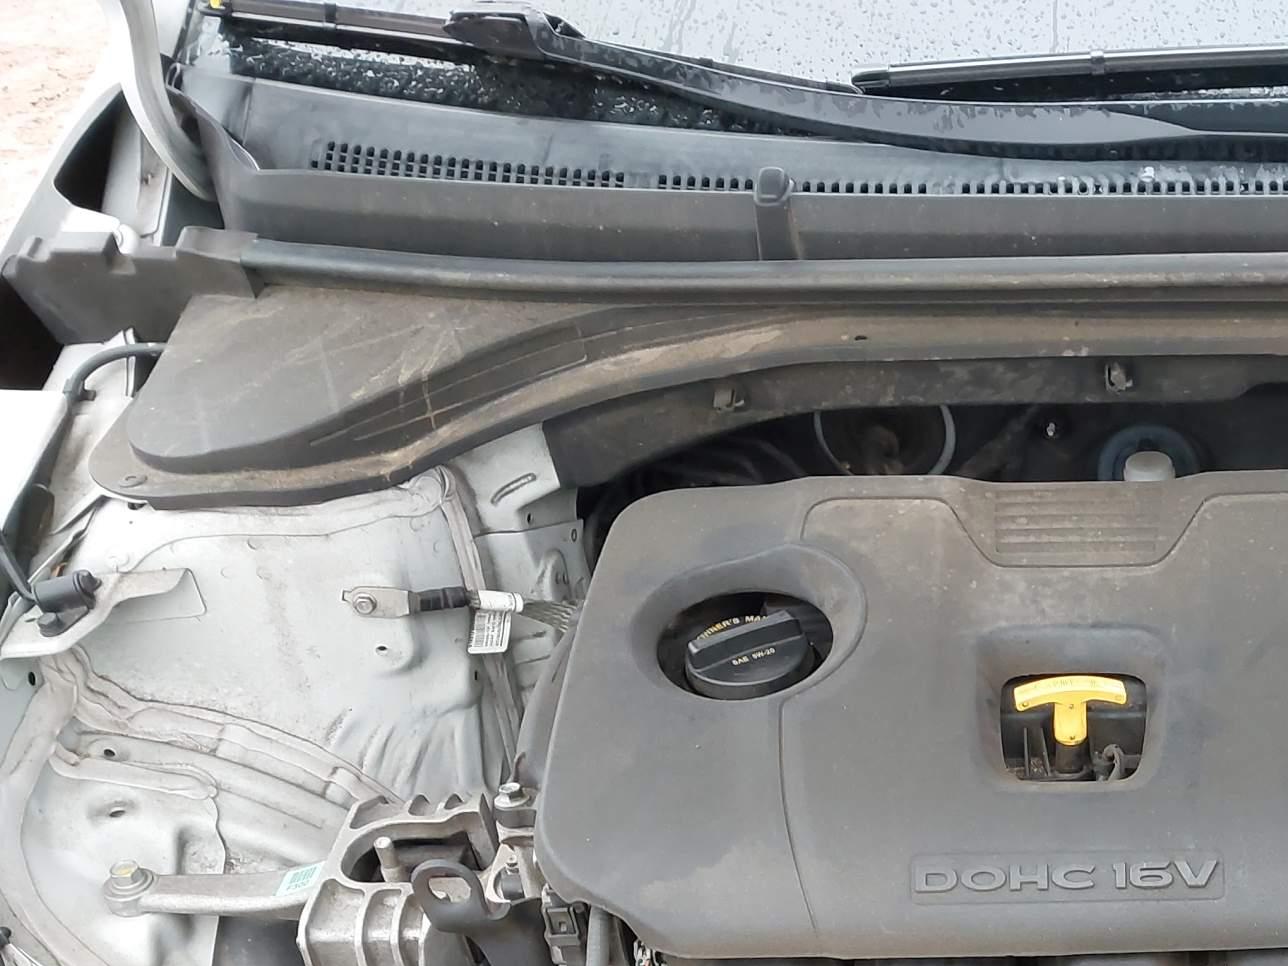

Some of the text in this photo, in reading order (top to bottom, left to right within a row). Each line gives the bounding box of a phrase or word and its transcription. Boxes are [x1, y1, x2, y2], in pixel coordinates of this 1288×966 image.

[732, 647, 776, 666] SAE 5W-20
[914, 859, 1219, 893] DOHC 16V
